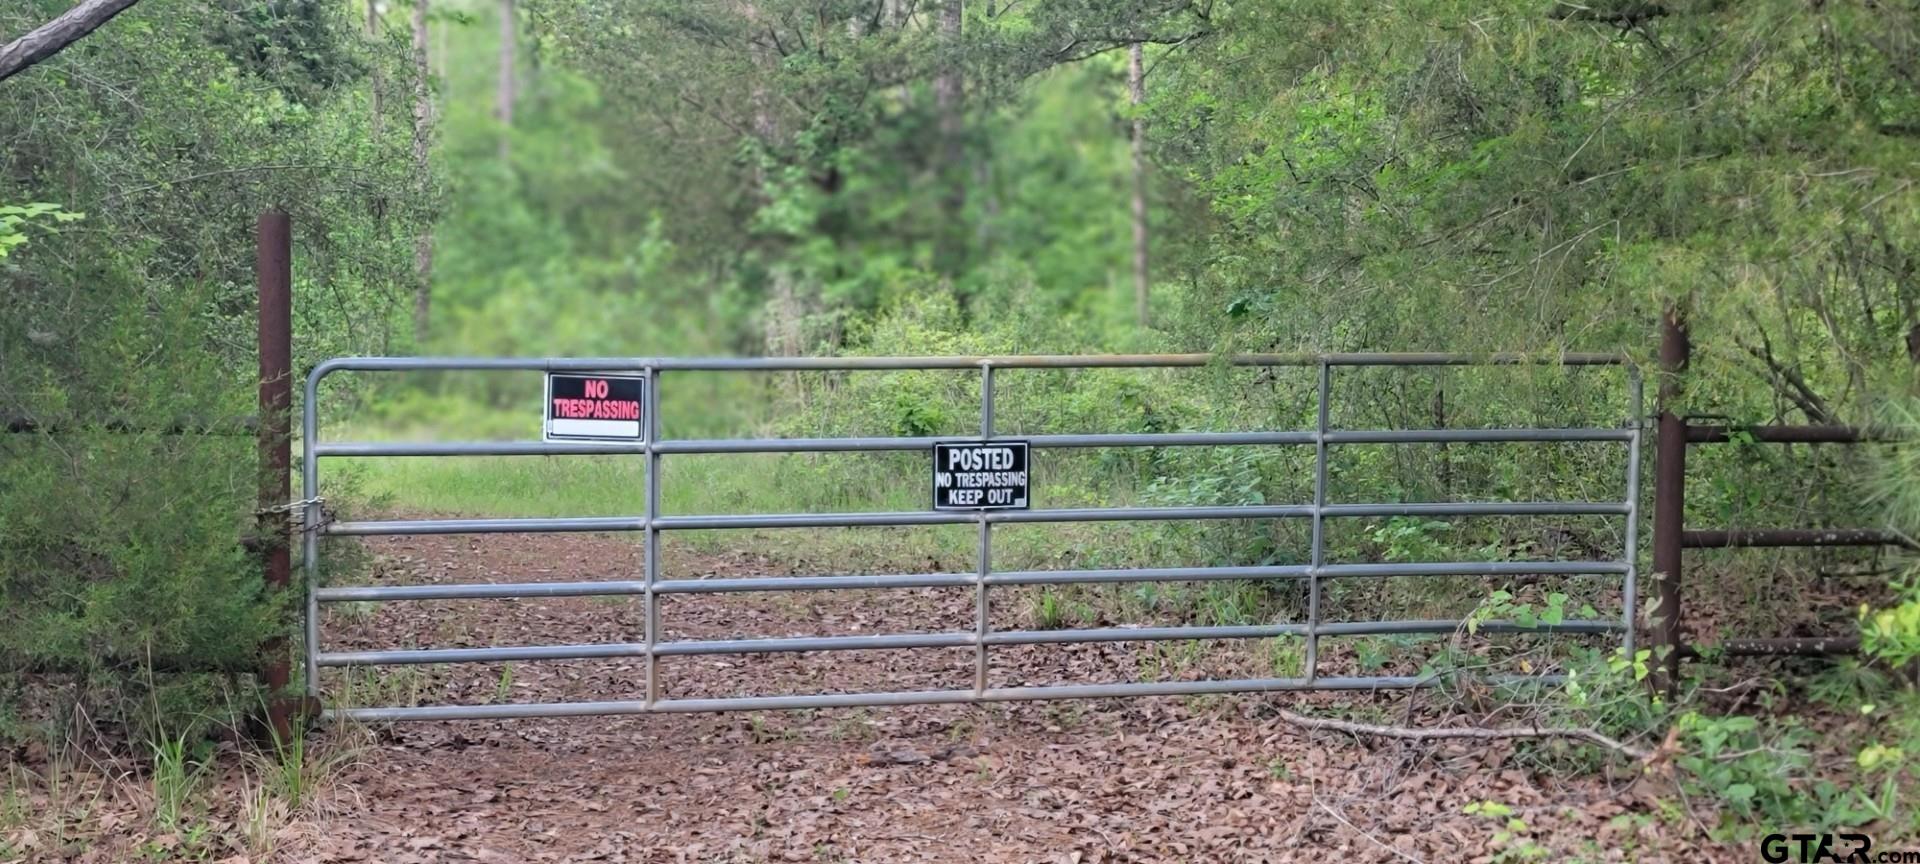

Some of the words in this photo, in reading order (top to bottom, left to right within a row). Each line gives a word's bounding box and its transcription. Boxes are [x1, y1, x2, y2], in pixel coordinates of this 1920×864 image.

[585, 380, 608, 399] NO
[554, 398, 639, 419] TRESPASSING
[949, 448, 1014, 470] POSTED
[937, 472, 952, 487] NO
[955, 472, 1025, 487] TRESPASSING
[949, 489, 983, 504] KEEP
[988, 488, 1013, 504] OUT
